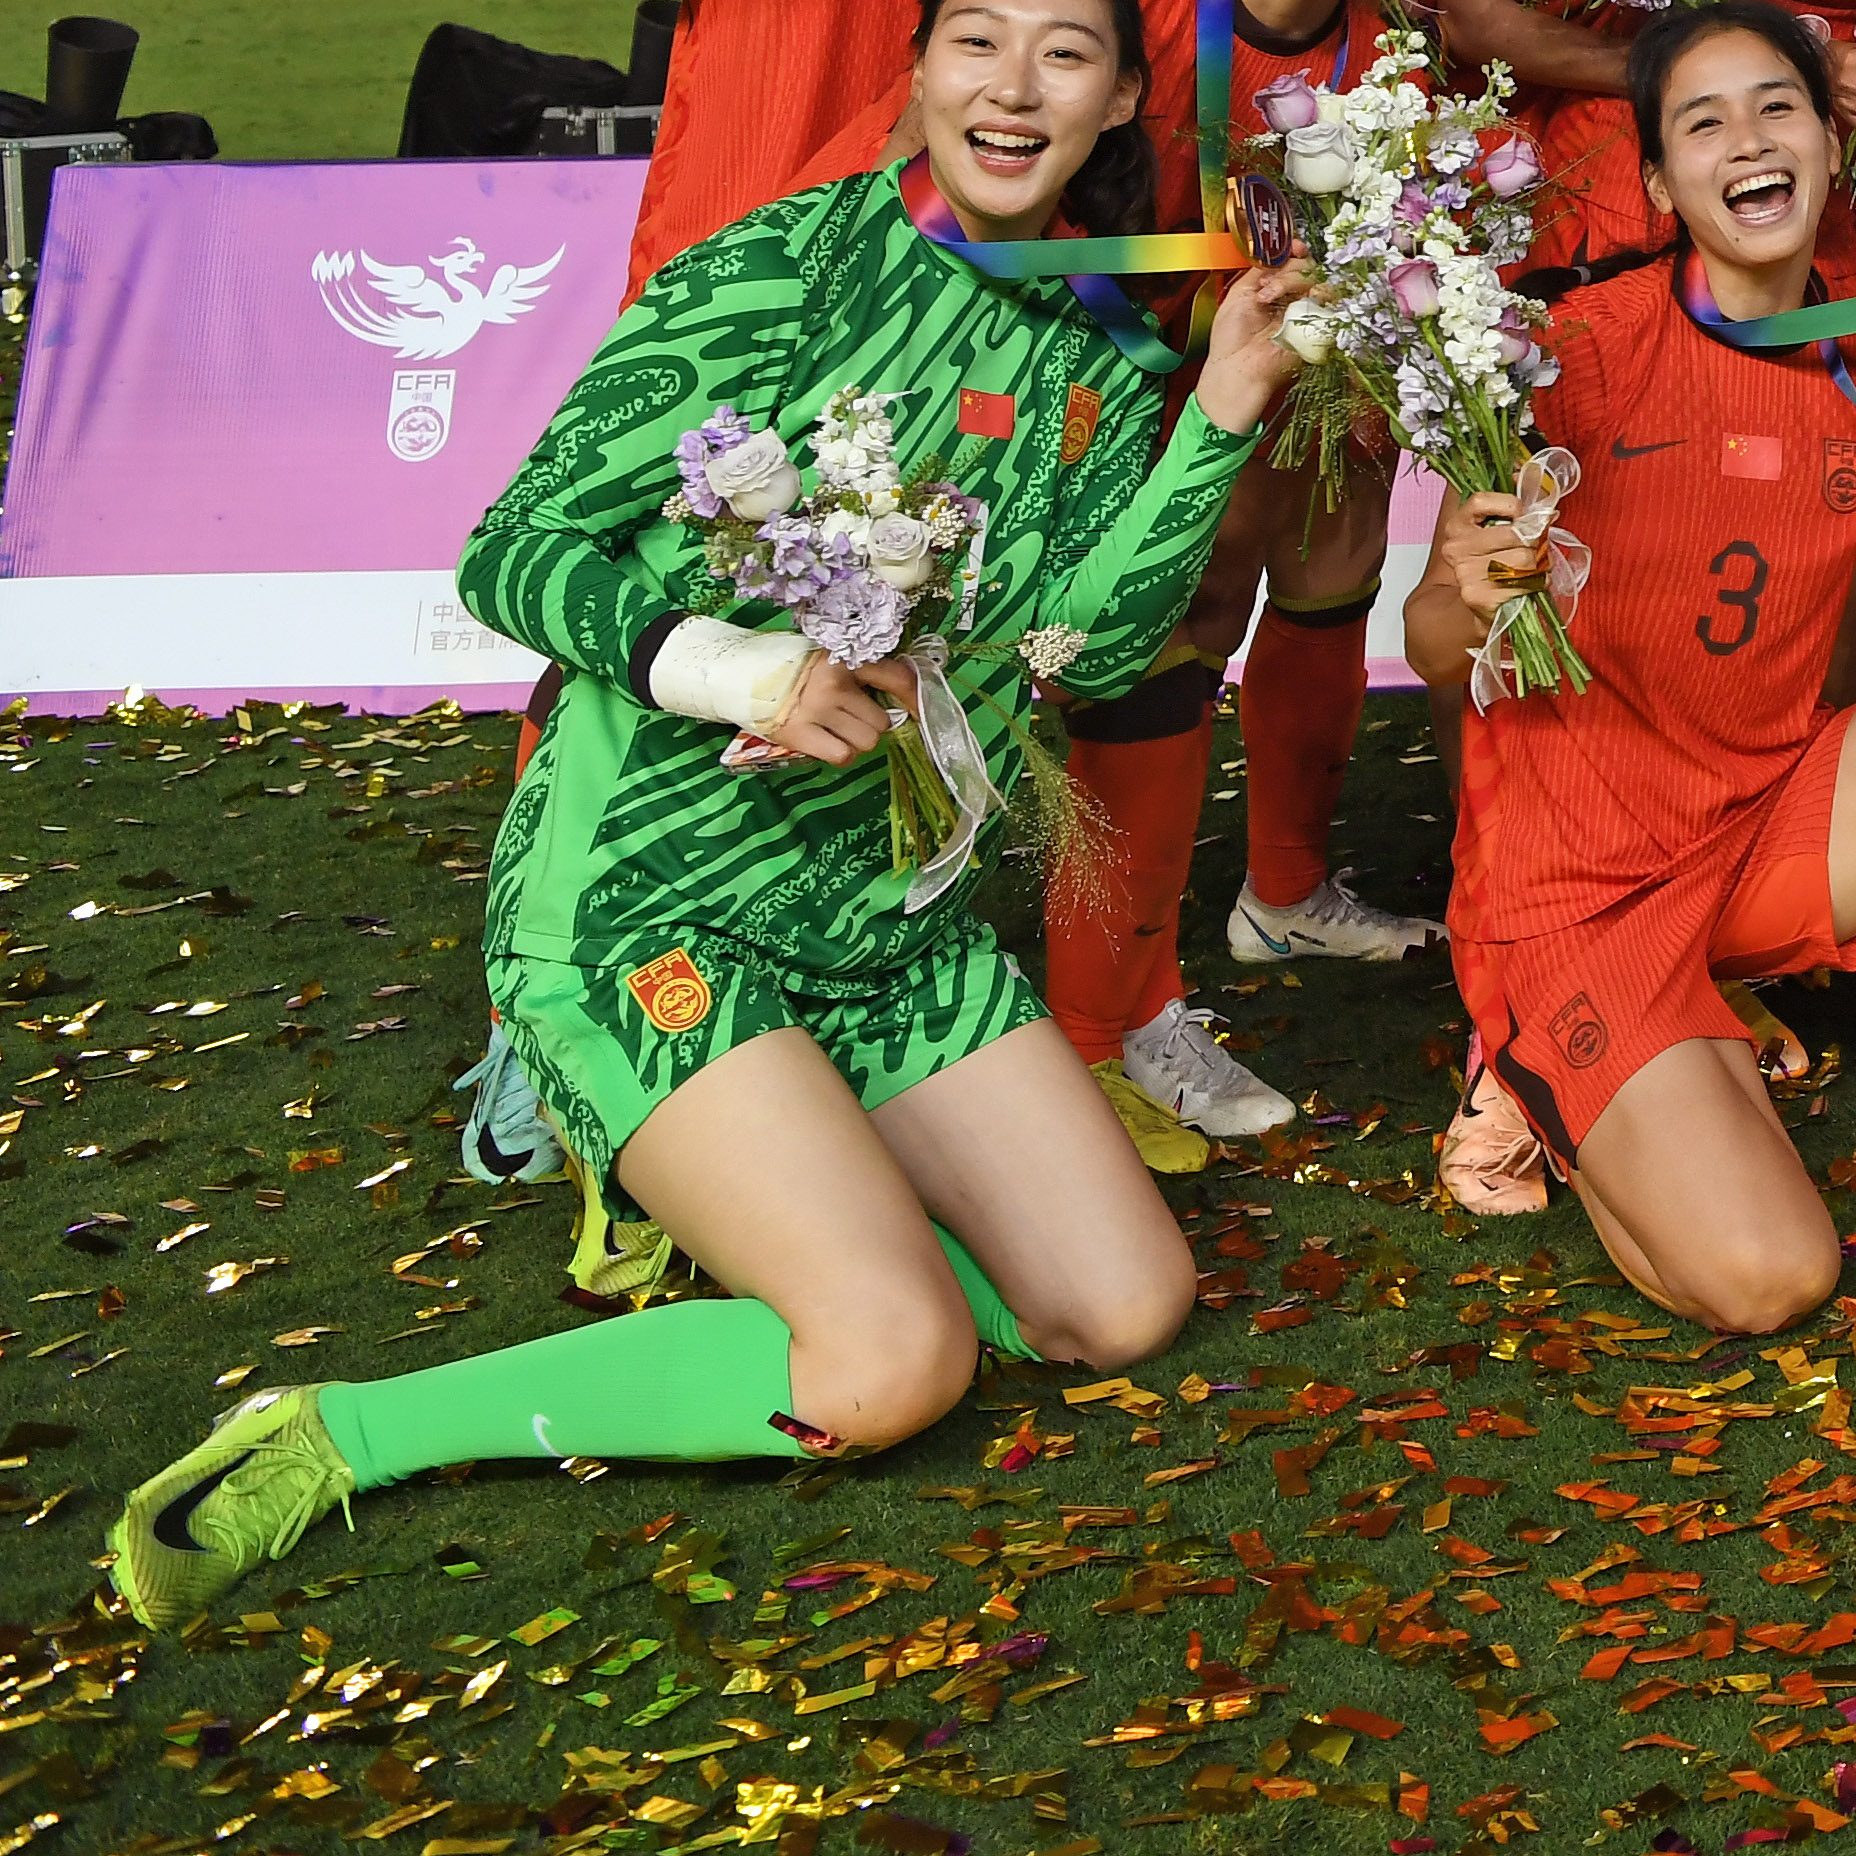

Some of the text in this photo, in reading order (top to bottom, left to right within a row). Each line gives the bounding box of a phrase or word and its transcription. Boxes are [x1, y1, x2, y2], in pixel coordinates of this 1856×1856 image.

[397, 374, 451, 391] CFA
[1072, 388, 1099, 411] CFA
[1695, 540, 1768, 655] 3
[631, 954, 682, 989] CFA
